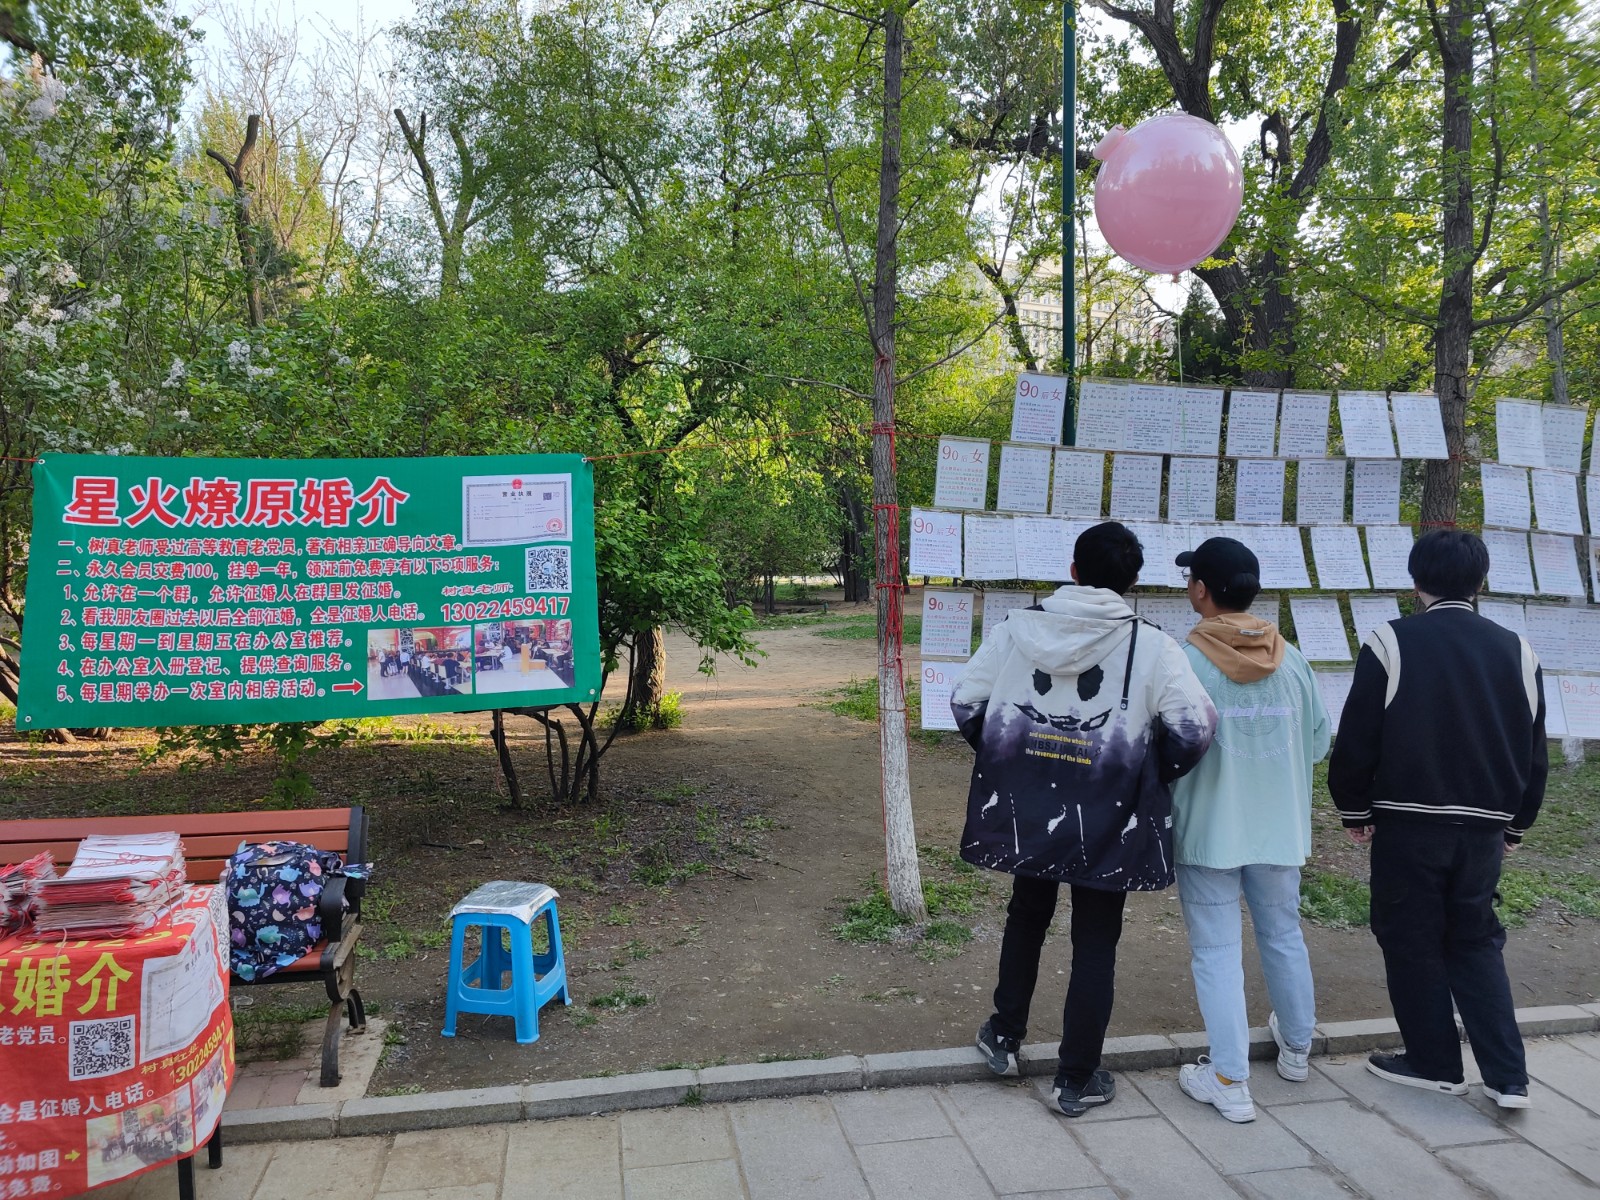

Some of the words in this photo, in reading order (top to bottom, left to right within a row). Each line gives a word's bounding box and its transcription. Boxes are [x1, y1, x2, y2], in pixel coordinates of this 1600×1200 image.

[63, 476, 411, 528] 星火燎原婚介
[440, 597, 571, 622] 13022459417
[59, 629, 353, 652] 3、每星期一到星期五在办公室推荐。
[57, 652, 352, 677] 4、在办公室入册登记、提供查询服务。
[56, 678, 326, 703] 5、每星期举办一次室内相亲活动。
[1063, 736, 1072, 744] the
[1025, 747, 1034, 756] the
[1034, 750, 1060, 760] revenues
[1060, 753, 1067, 761] of
[1066, 754, 1076, 763] the
[0, 952, 134, 1018] 婚介
